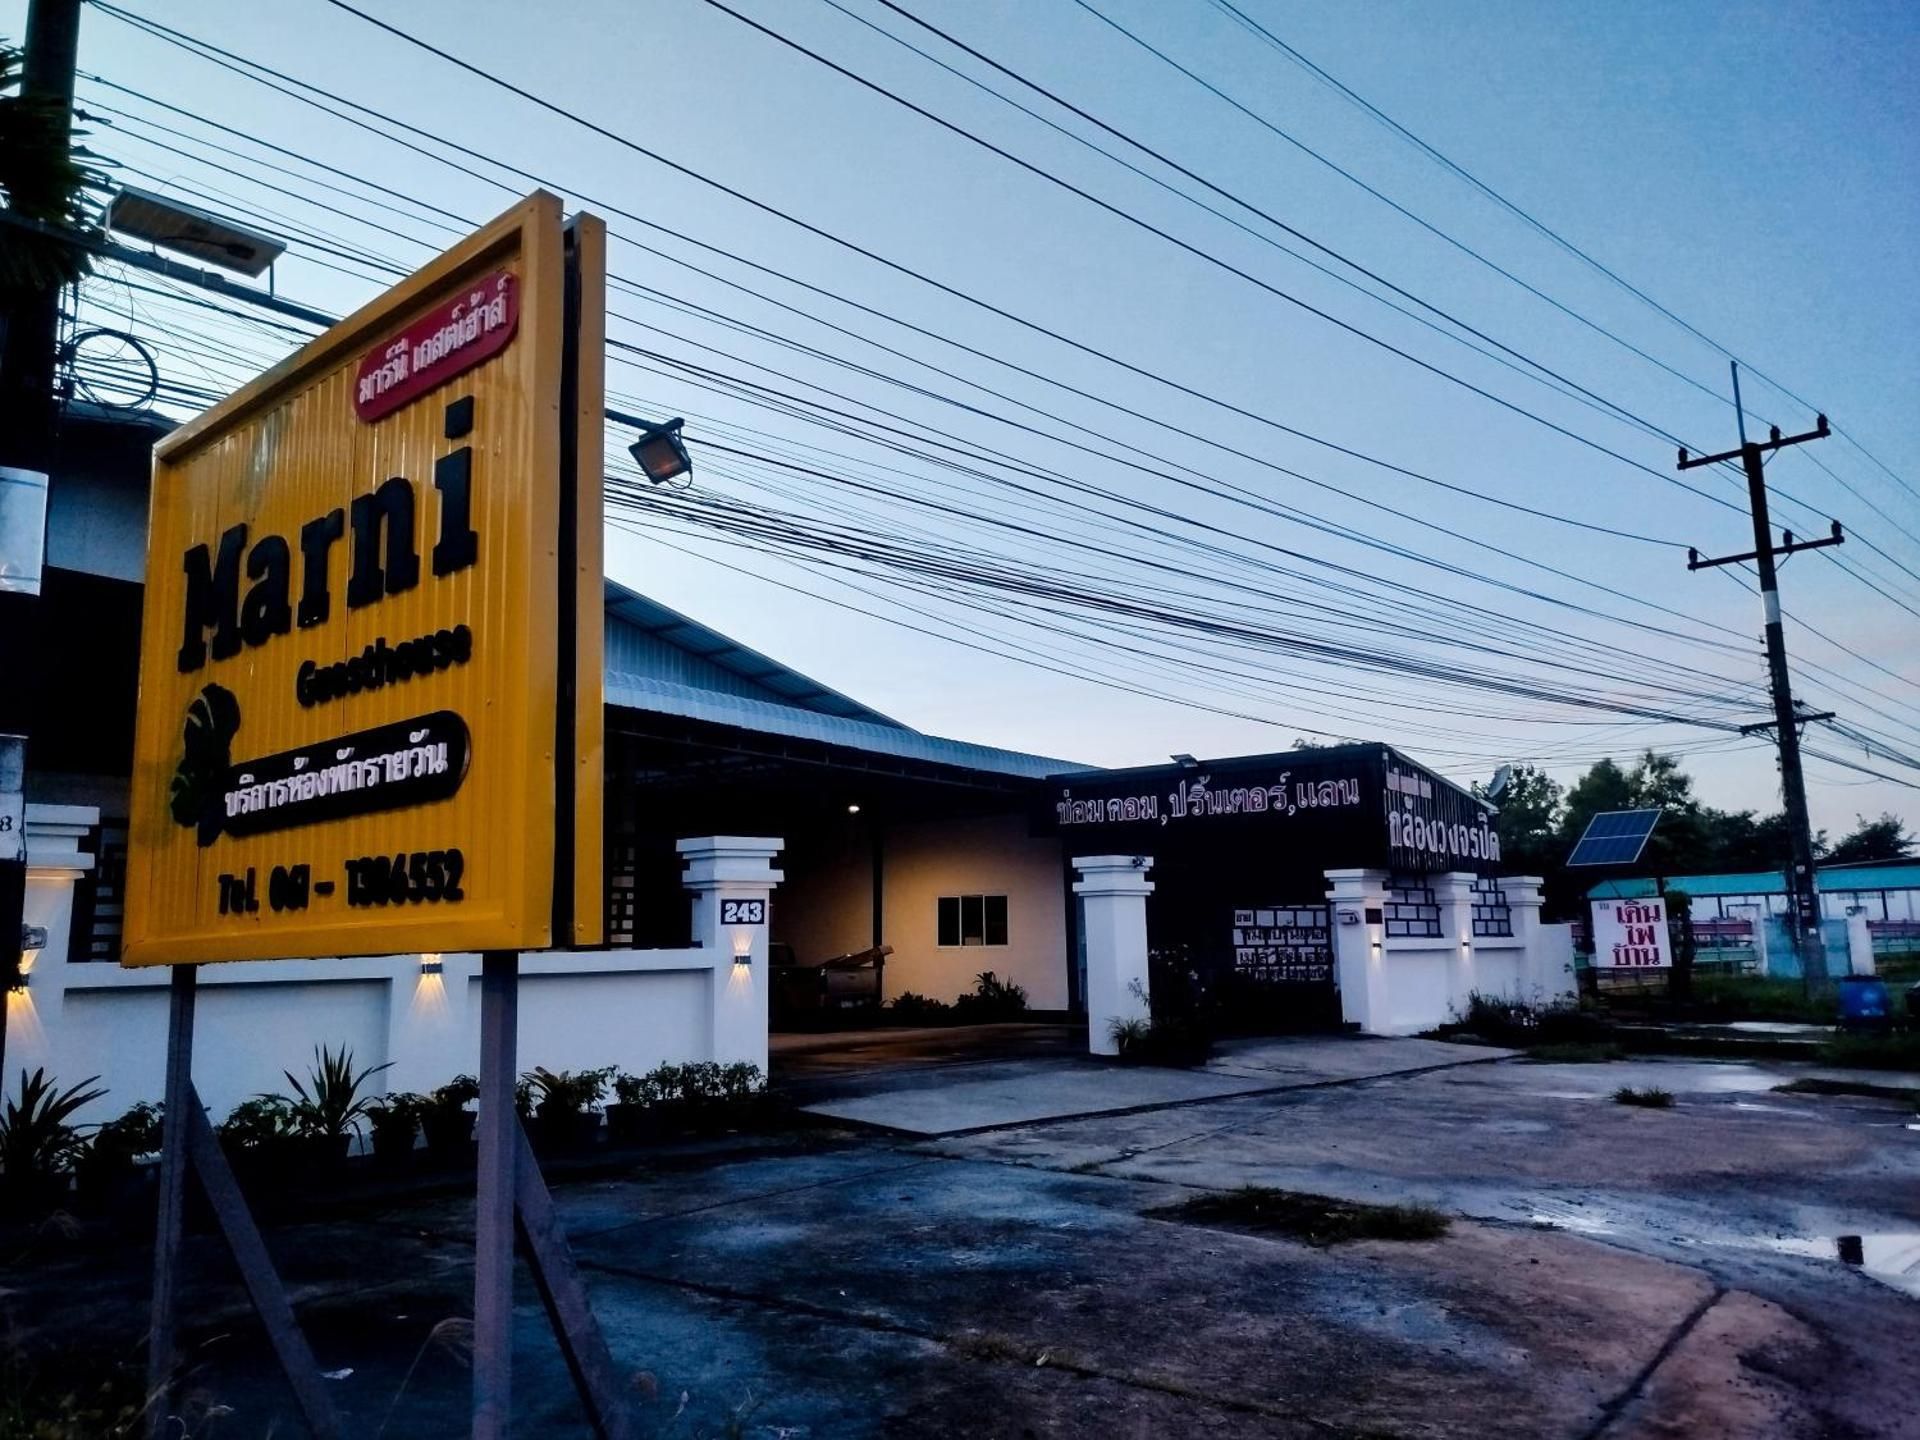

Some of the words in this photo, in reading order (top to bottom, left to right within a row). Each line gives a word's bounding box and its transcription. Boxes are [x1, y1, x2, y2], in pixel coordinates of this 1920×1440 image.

[178, 396, 478, 673] Marni
[297, 625, 472, 708] Guesthouse
[225, 729, 449, 817] บริการห้องพักรายวัน
[1389, 796, 1500, 861] กล้องวงจรปิด
[725, 902, 762, 922] 243
[1612, 943, 1661, 966] บ้าน
